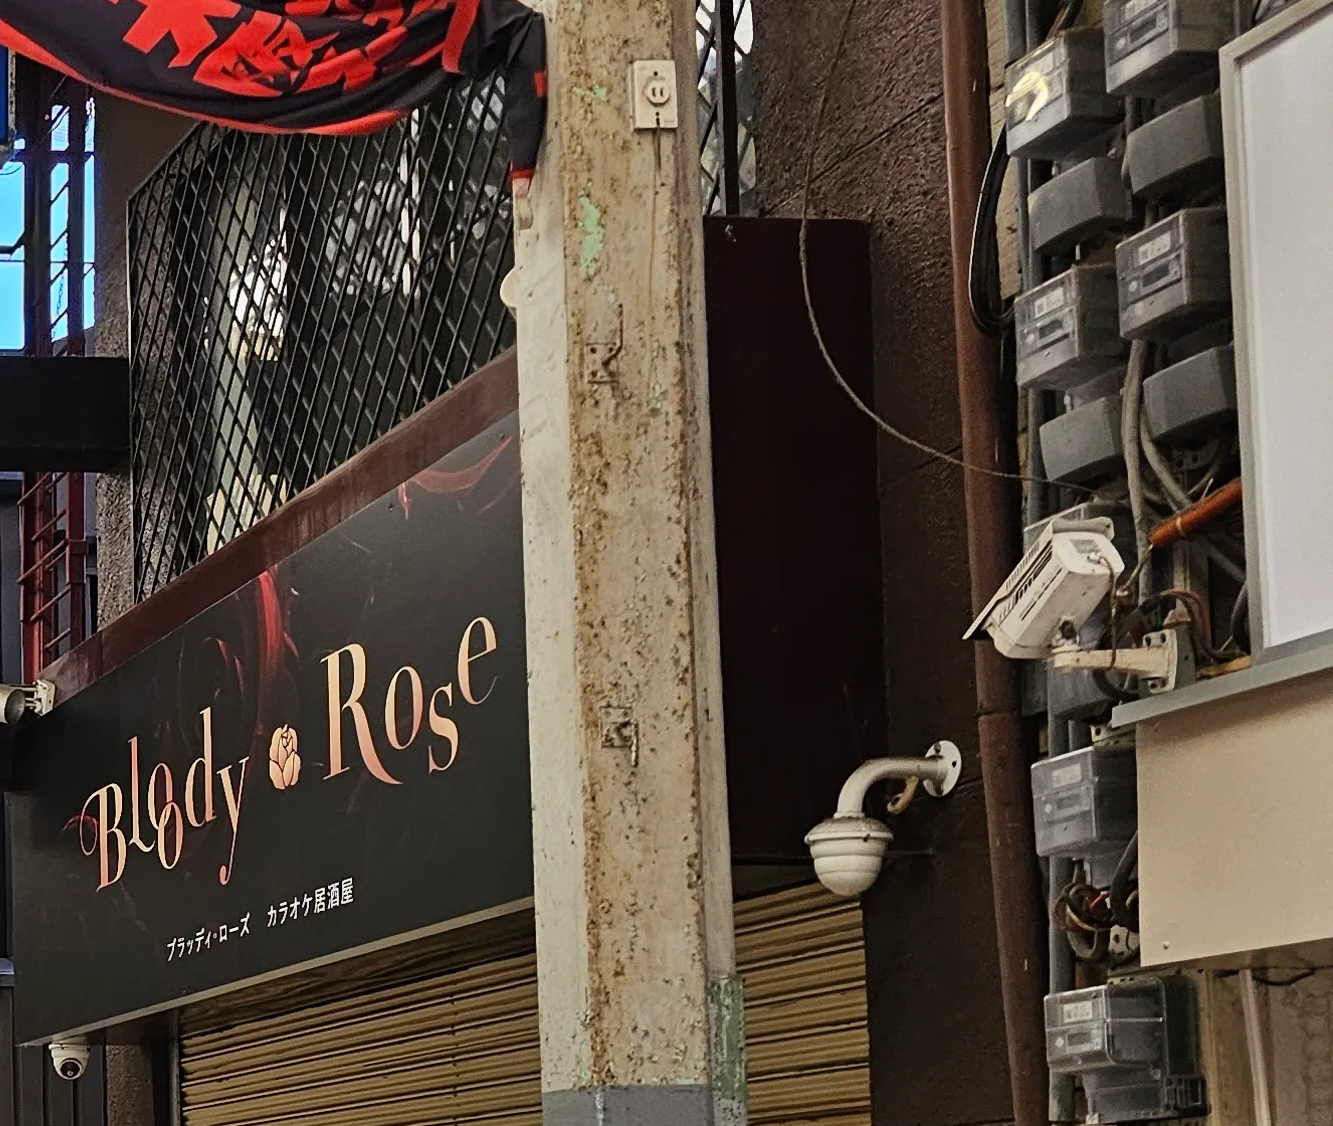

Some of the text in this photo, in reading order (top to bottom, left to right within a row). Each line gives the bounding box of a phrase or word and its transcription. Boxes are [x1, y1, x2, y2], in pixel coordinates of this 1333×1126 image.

[63, 615, 499, 892] Bloody Rose
[166, 877, 354, 962] ブラッディ・ローズ カラオケ居酒屋
